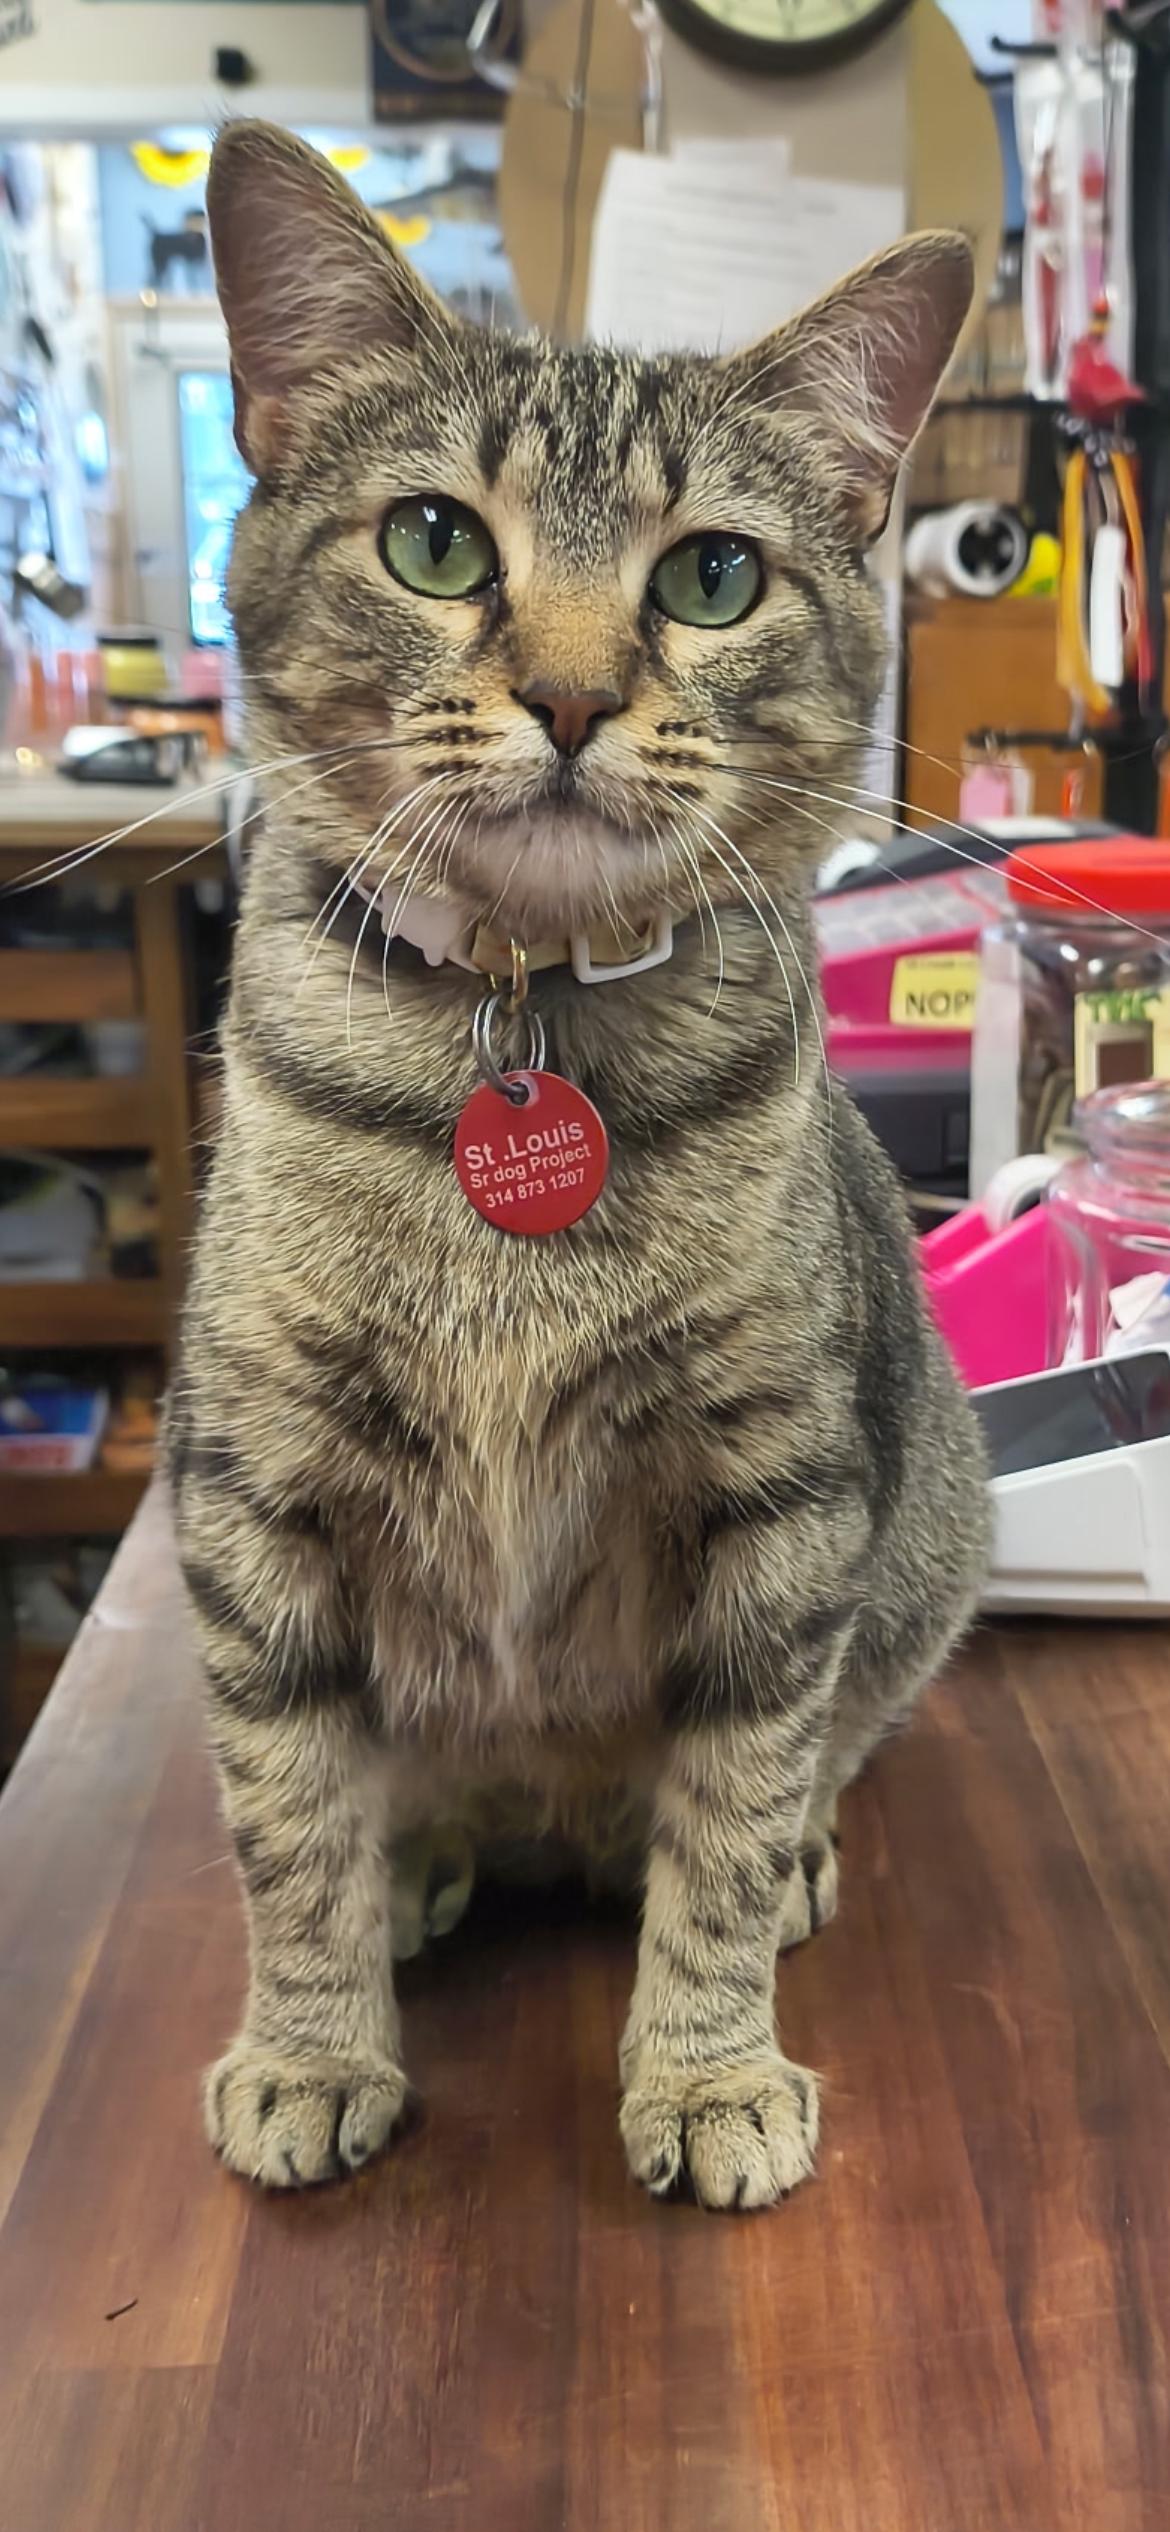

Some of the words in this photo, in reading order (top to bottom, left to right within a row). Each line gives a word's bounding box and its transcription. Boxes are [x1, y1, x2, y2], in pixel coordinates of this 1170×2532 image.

[905, 990, 975, 1018] NOP
[464, 1143, 496, 1170] St
[470, 1173, 489, 1189] Sr
[494, 1166, 527, 1182] dog
[529, 1143, 592, 1173] Project
[485, 1188, 514, 1208] 314
[517, 1179, 546, 1199] 873
[549, 1167, 584, 1190] 1207
